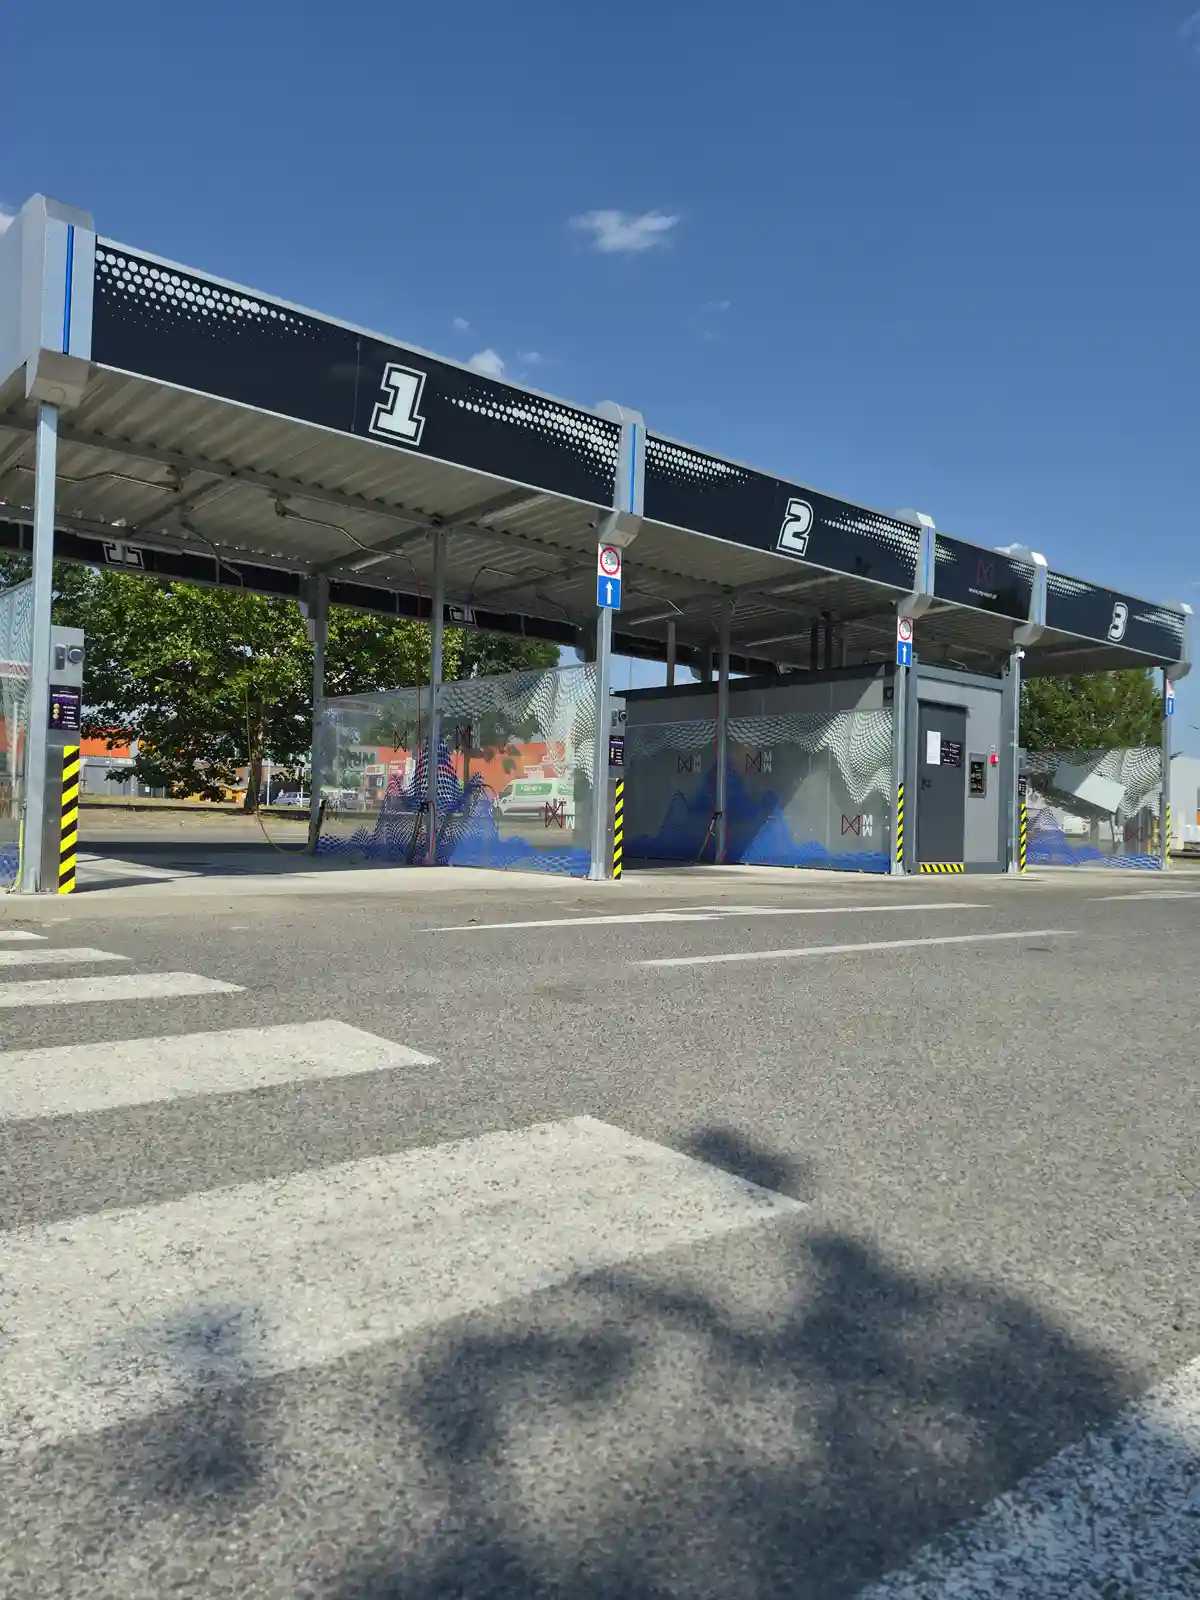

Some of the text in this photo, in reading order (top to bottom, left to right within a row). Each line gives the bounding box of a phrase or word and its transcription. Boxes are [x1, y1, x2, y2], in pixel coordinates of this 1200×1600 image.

[368, 362, 427, 446] 1
[776, 497, 814, 557] 2
[1107, 601, 1129, 642] 3
